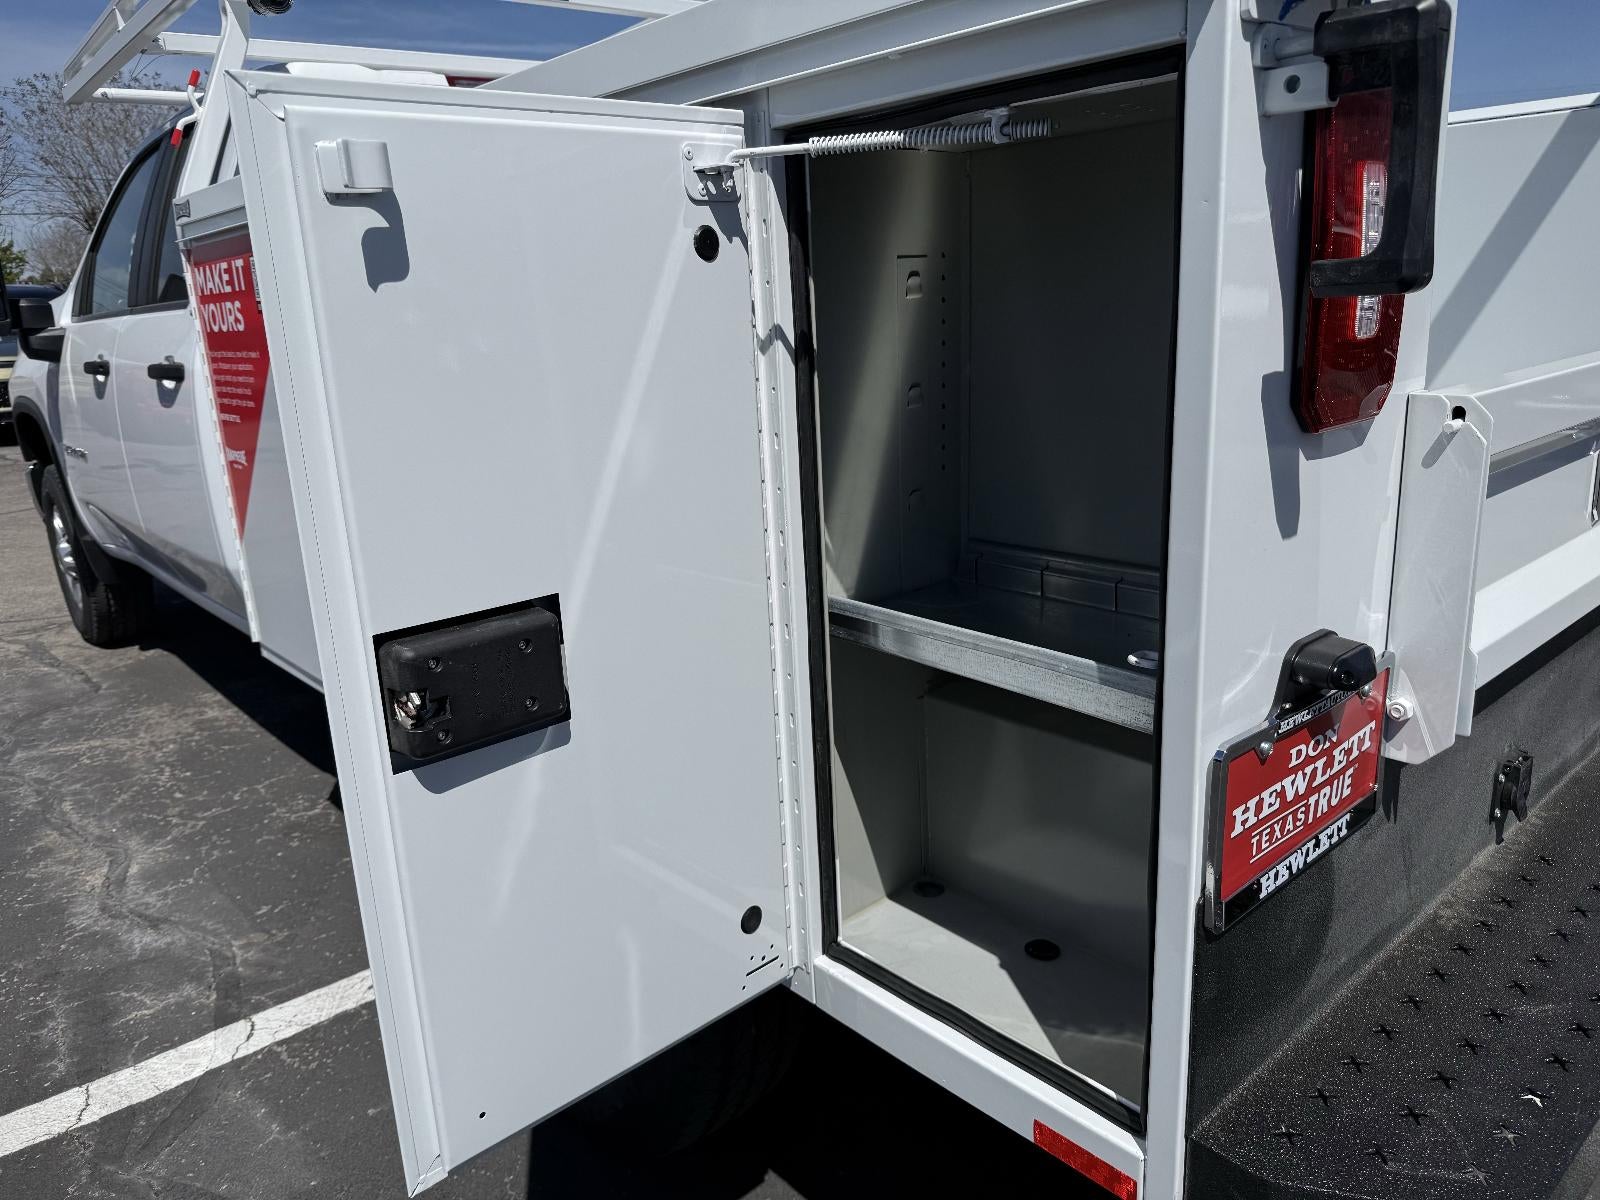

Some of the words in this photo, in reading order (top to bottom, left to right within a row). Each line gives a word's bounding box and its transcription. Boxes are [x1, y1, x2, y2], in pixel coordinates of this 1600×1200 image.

[194, 262, 232, 296] MAKE
[231, 259, 246, 291] IT
[200, 301, 245, 332] YOURS
[1289, 723, 1340, 768] DON
[1231, 720, 1376, 838] HEWLETT
[1259, 813, 1350, 899] HEWLETT
